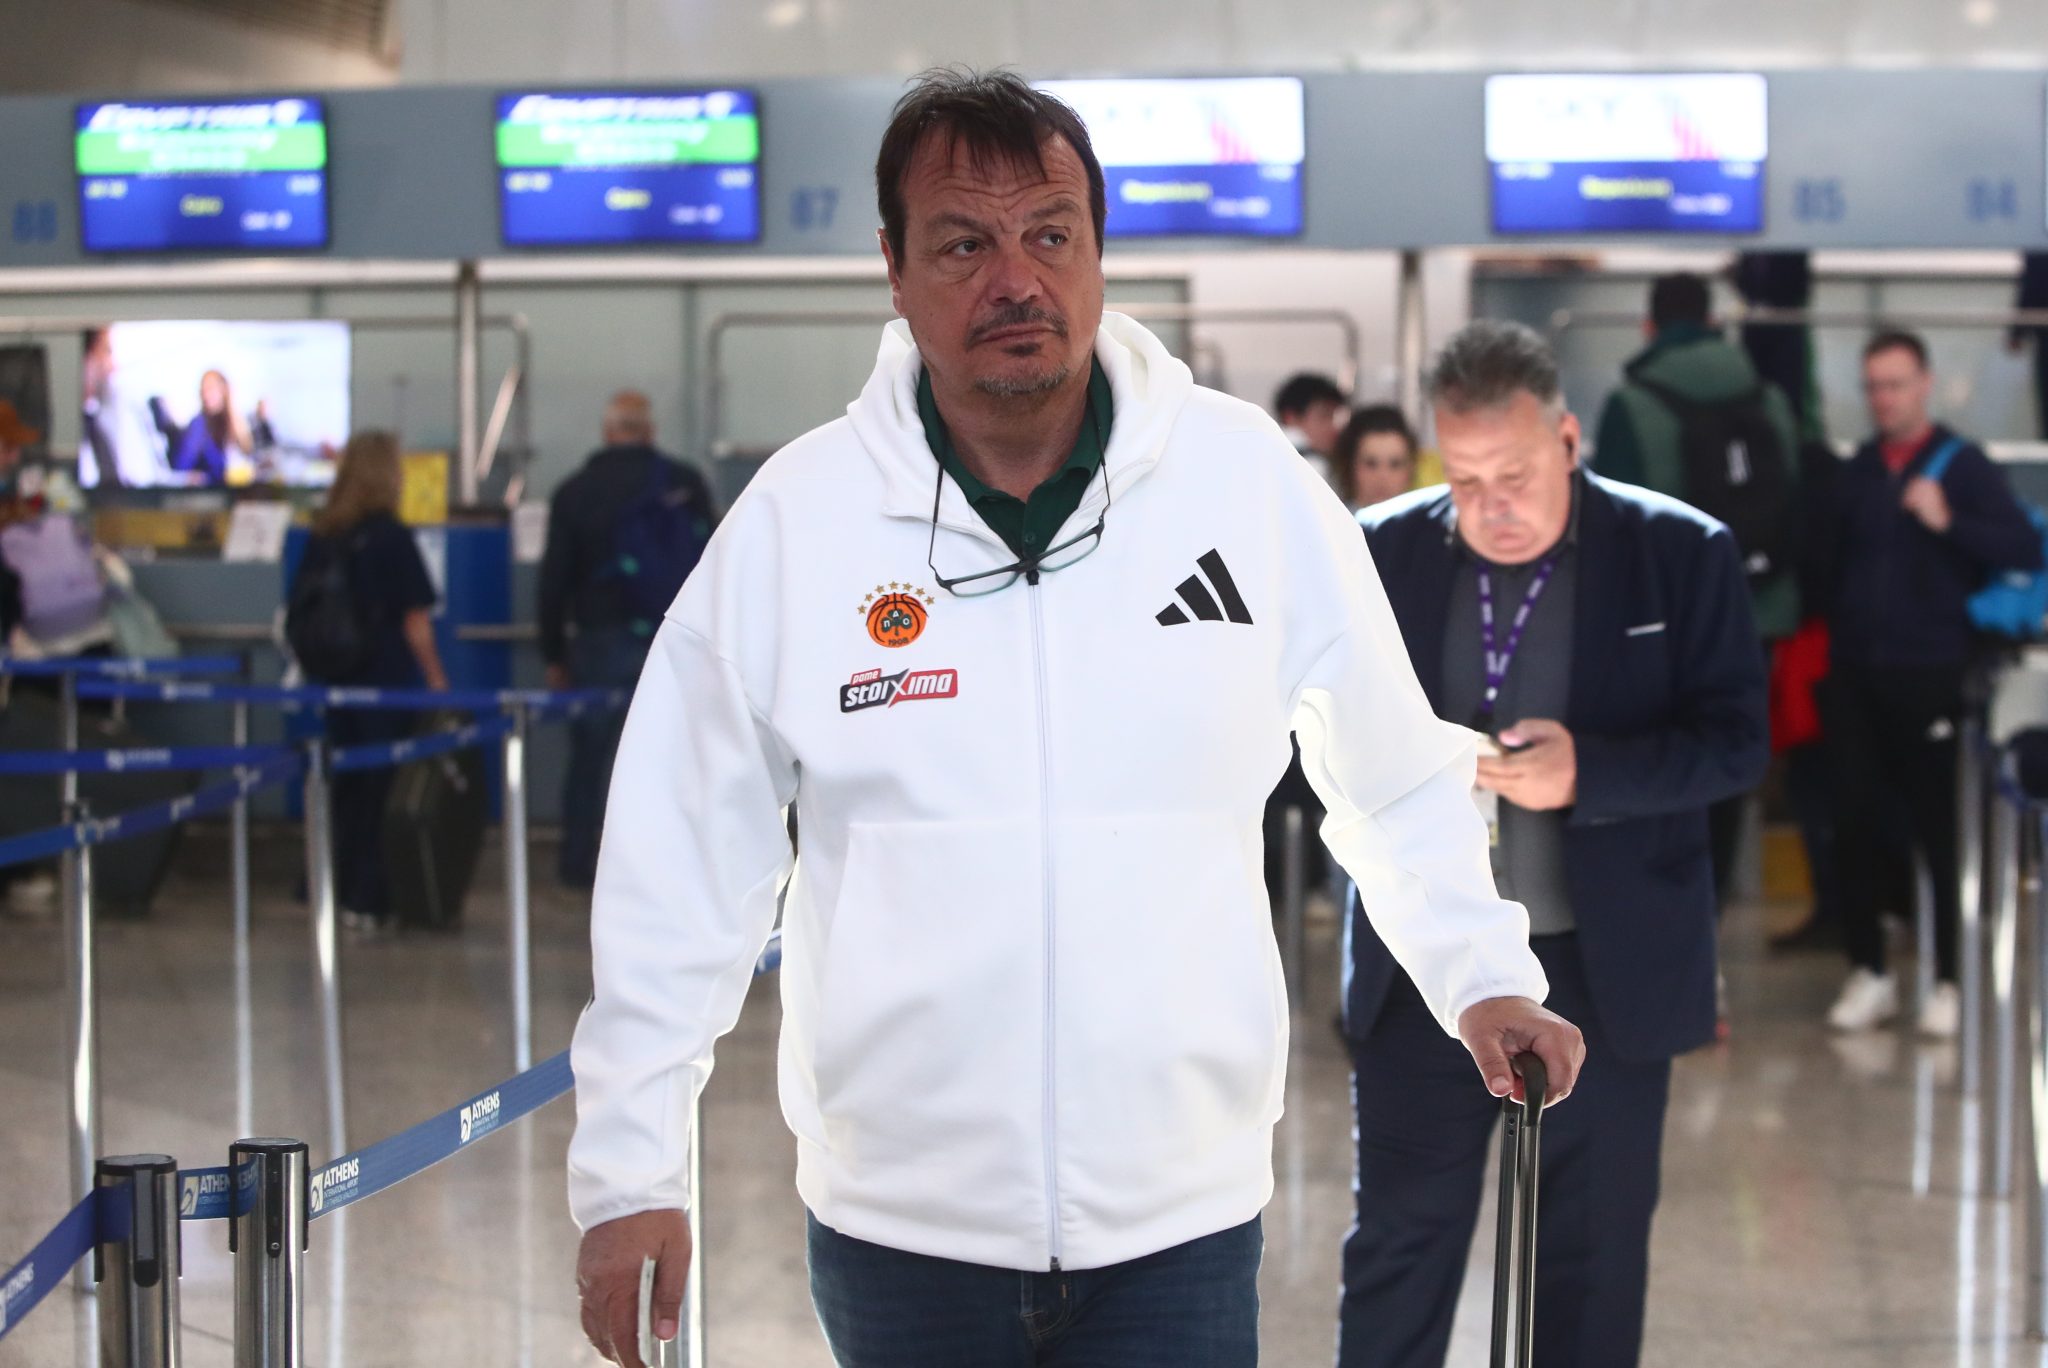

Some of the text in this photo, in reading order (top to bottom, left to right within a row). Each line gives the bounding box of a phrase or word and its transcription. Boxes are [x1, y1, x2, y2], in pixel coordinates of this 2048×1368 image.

[852, 670, 879, 685] pame
[472, 1090, 500, 1121] ATHENS
[200, 1174, 230, 1194] ATHEN
[323, 1157, 359, 1189] ATHENS
